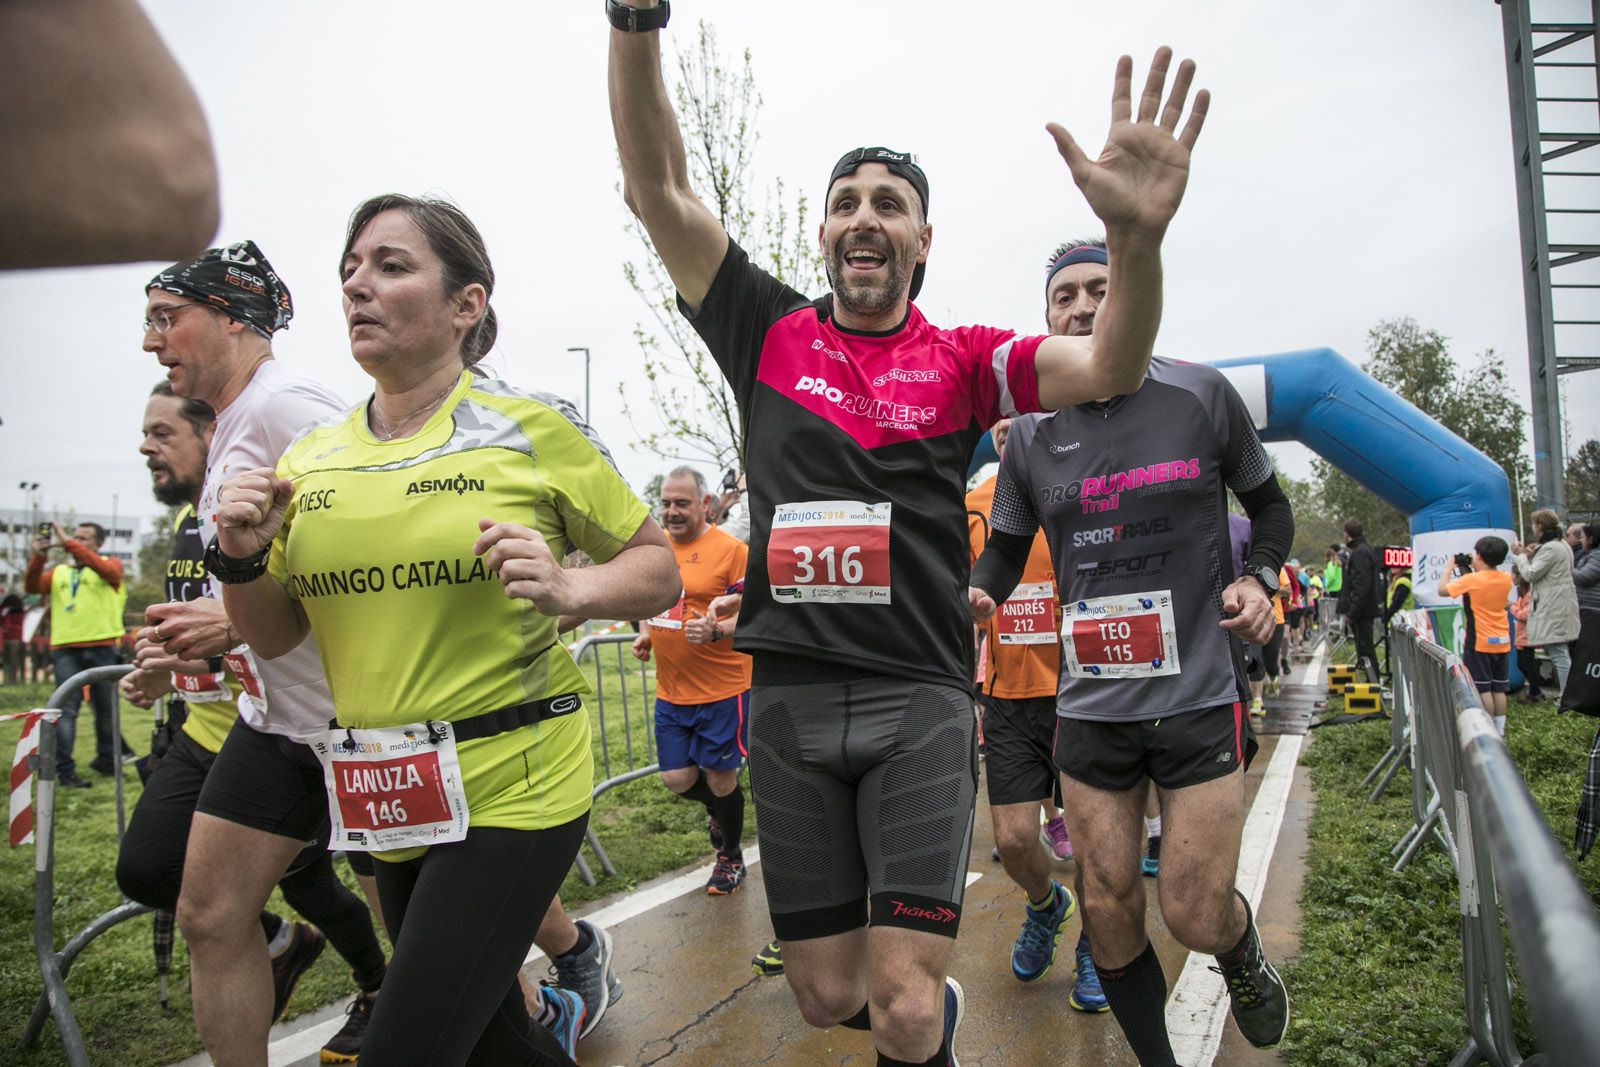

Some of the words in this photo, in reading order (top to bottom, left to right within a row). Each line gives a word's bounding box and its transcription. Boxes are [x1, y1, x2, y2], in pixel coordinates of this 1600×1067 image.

[1040, 458, 1200, 505] PRORUNNERS
[1080, 494, 1120, 515] Trail
[392, 557, 500, 590] CATALA
[792, 545, 864, 584] 316
[1002, 599, 1046, 616] ANDRÉS
[1013, 618, 1035, 632] 212
[1099, 621, 1131, 641] TEO
[1103, 643, 1133, 662] 115
[343, 763, 424, 793] LANUZA
[365, 798, 408, 826] 146
